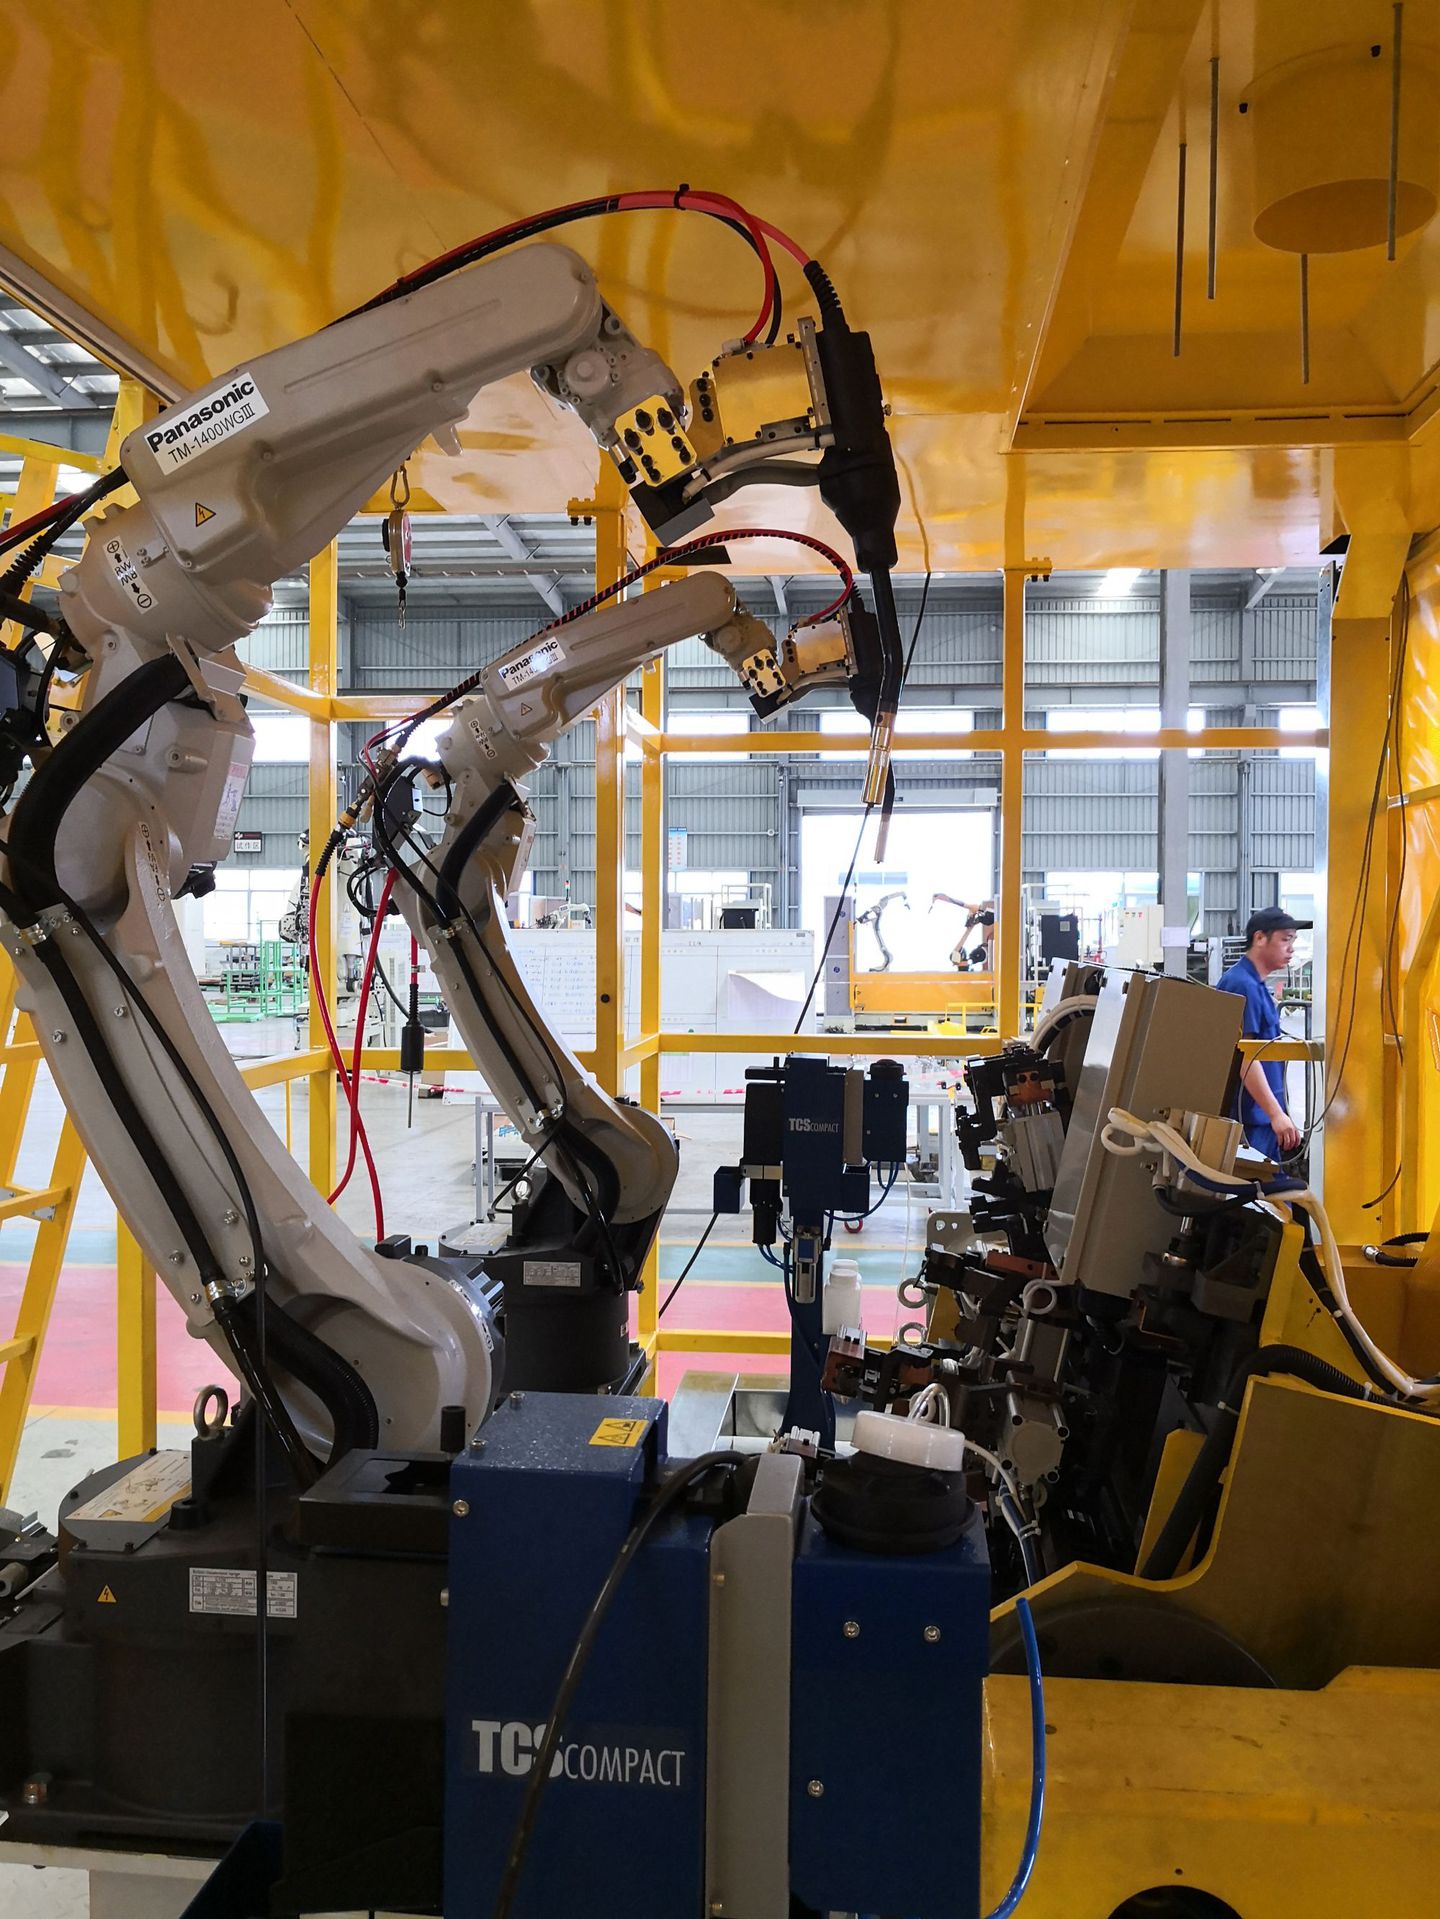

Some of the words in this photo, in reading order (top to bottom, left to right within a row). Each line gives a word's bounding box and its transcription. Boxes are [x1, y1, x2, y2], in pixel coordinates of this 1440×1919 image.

[147, 380, 255, 453] Panasonic
[788, 1118, 811, 1132] TCS
[810, 1122, 839, 1133] COMPACT
[564, 1743, 685, 1786] COMPACT
